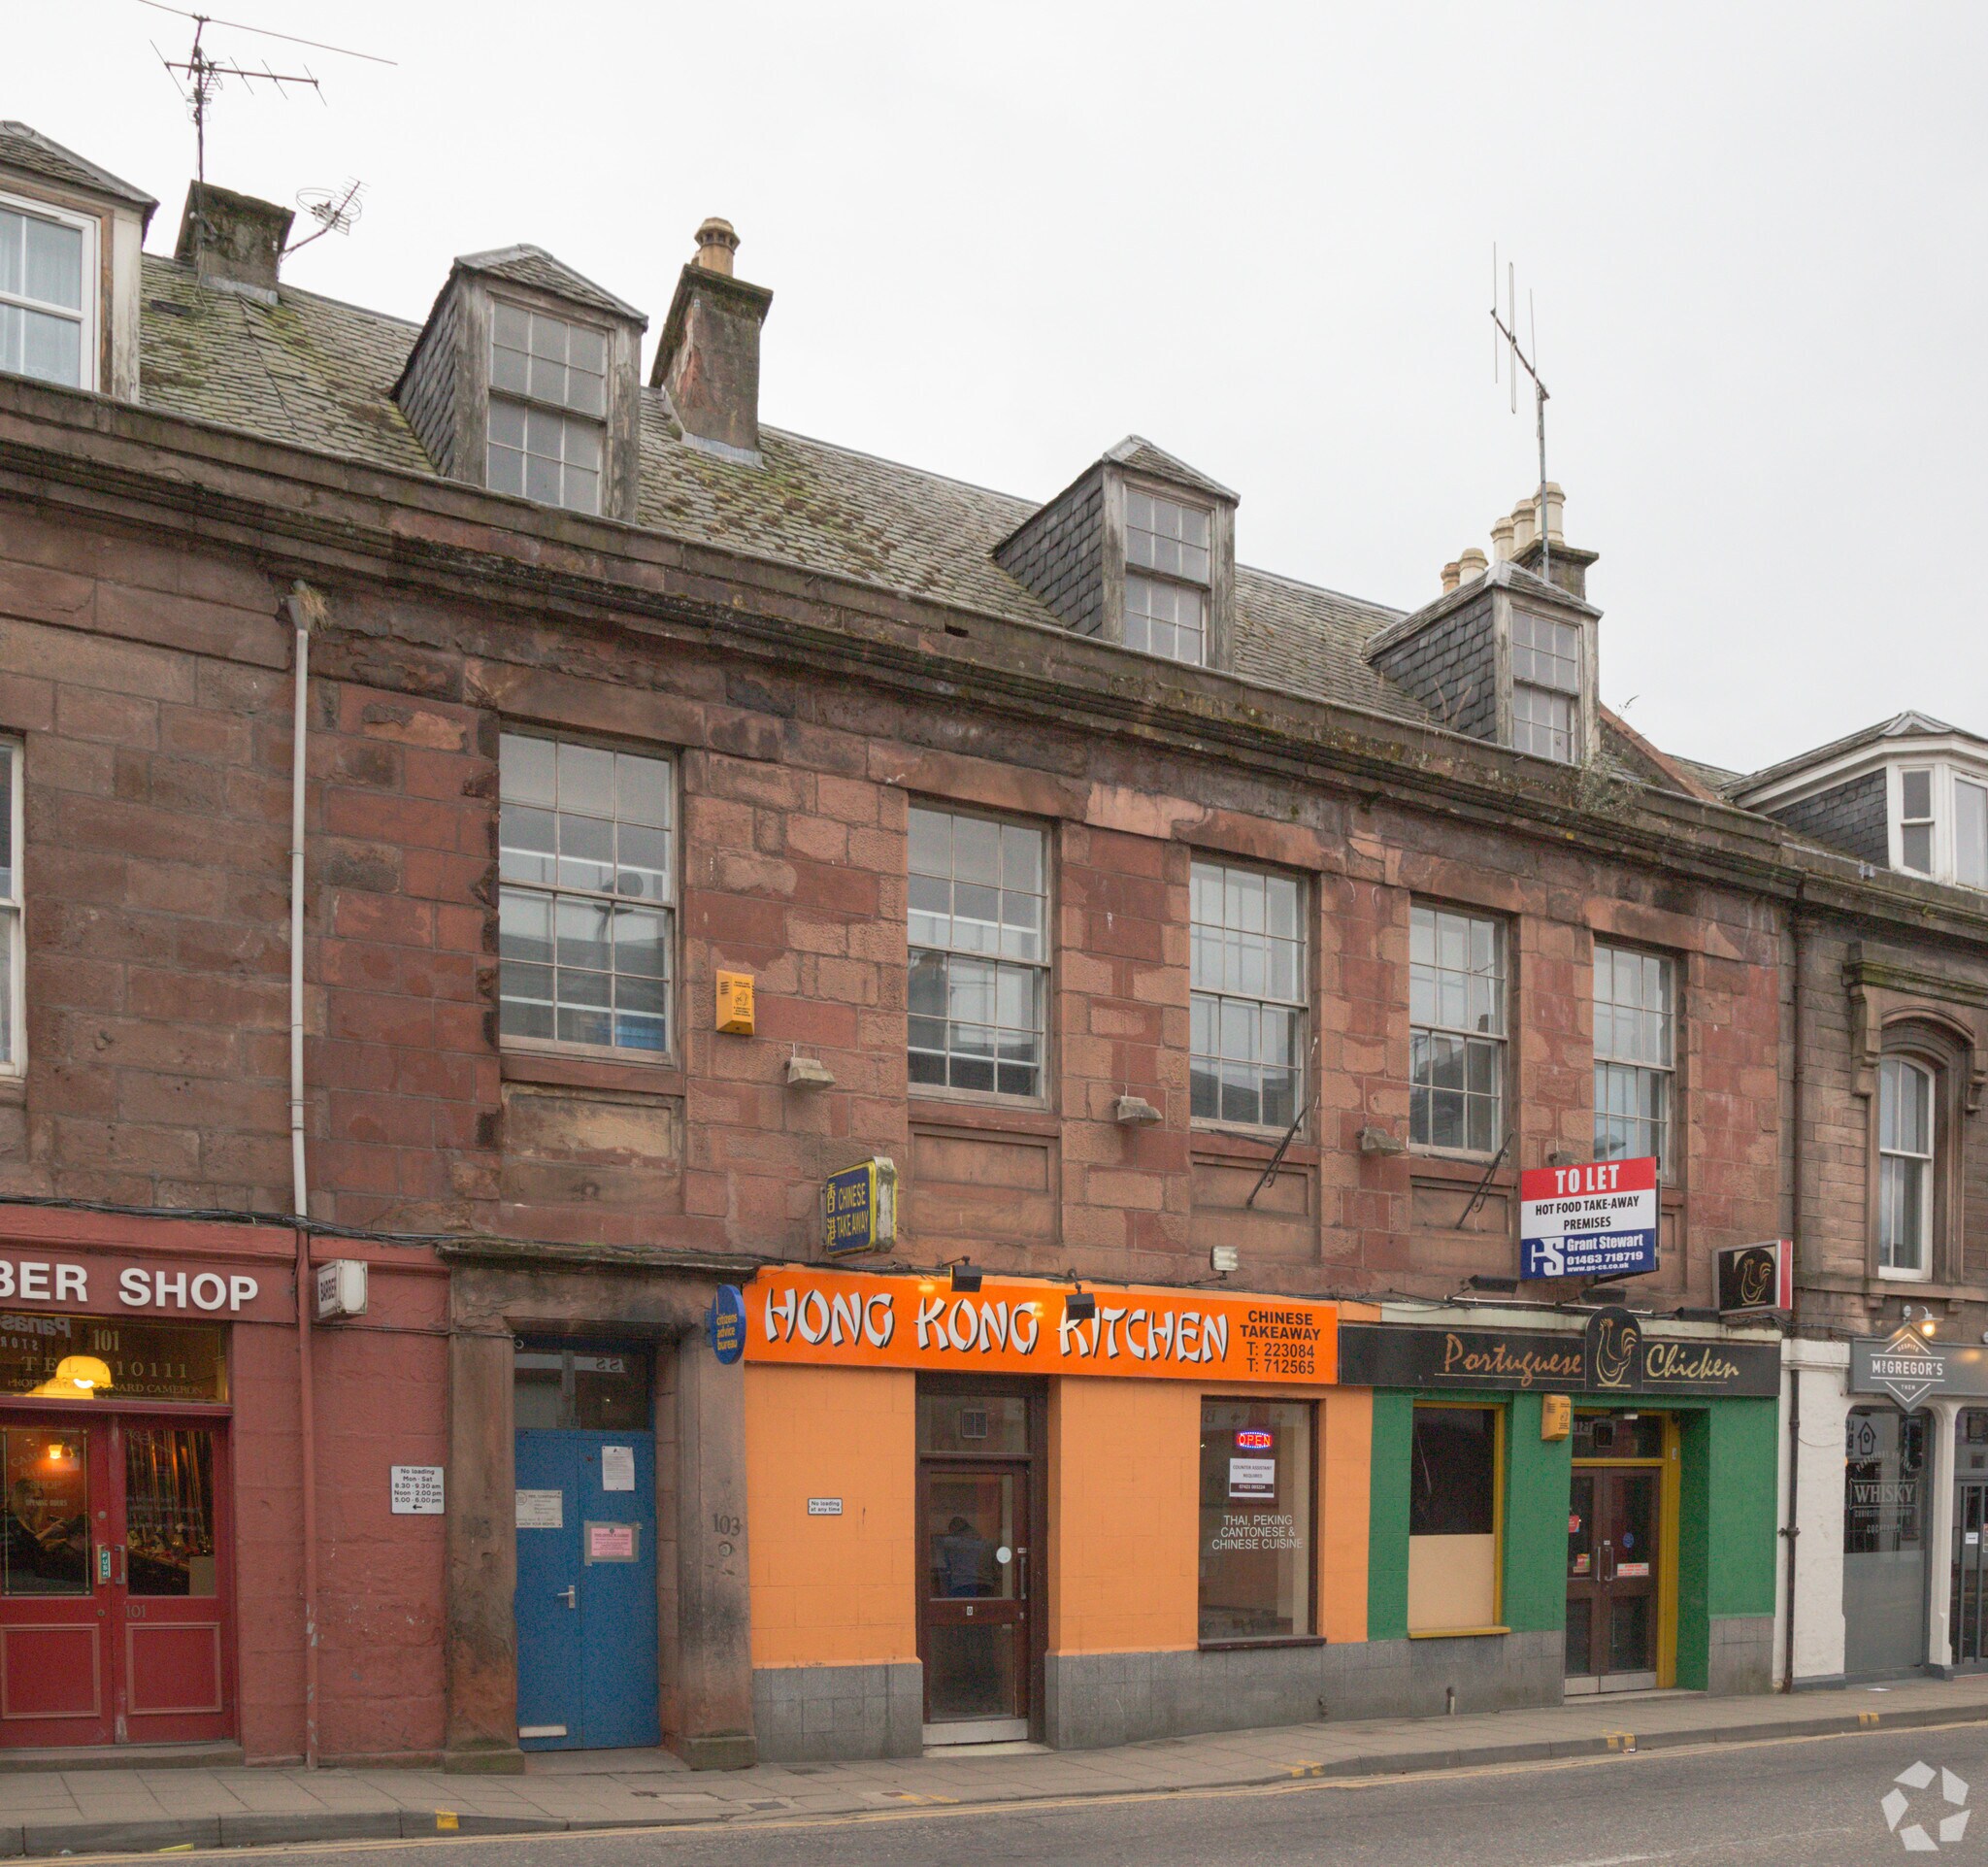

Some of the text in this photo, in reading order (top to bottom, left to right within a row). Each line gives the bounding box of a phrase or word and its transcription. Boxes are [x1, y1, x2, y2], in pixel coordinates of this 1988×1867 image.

[1555, 1164, 1619, 1194] TO LET
[838, 1183, 866, 1211] CHINESE
[1536, 1196, 1640, 1216] HOT FOOD TAKE-AWAY
[827, 1183, 836, 1246] 香港
[837, 1210, 869, 1238] TAKE AWAY
[1564, 1217, 1611, 1230] PREMISES
[1567, 1234, 1643, 1251] Grant Stewart
[1567, 1251, 1643, 1265] 01463 718719
[1567, 1262, 1630, 1272] www.gs-cs.co.uk
[118, 1267, 258, 1311] SHOP
[716, 1314, 738, 1325] citizens
[765, 1287, 1228, 1363] HONG KONG KITCHEN
[1247, 1311, 1313, 1326] CHINESE
[716, 1324, 736, 1338] advice
[1240, 1325, 1321, 1341] TAKEAWAY
[93, 1328, 119, 1351] 101
[717, 1339, 738, 1350] bureau
[1897, 1343, 1919, 1352] DESPITE
[1246, 1342, 1315, 1358] T: 223084
[21, 1355, 79, 1374] TEL
[1246, 1358, 1315, 1375] T: 712565
[1444, 1333, 1740, 1387] Portuguese Chicken
[146, 1384, 203, 1395] CAMERON
[1238, 1434, 1271, 1447] OPEN
[1854, 1484, 1915, 1503] WHISKY
[713, 1514, 741, 1536] 103
[1223, 1515, 1293, 1526] THAI, PEKING
[1220, 1526, 1296, 1538] CANTONESE &
[1211, 1538, 1303, 1550] CHINESE CUISINE
[125, 1604, 147, 1618] 101
